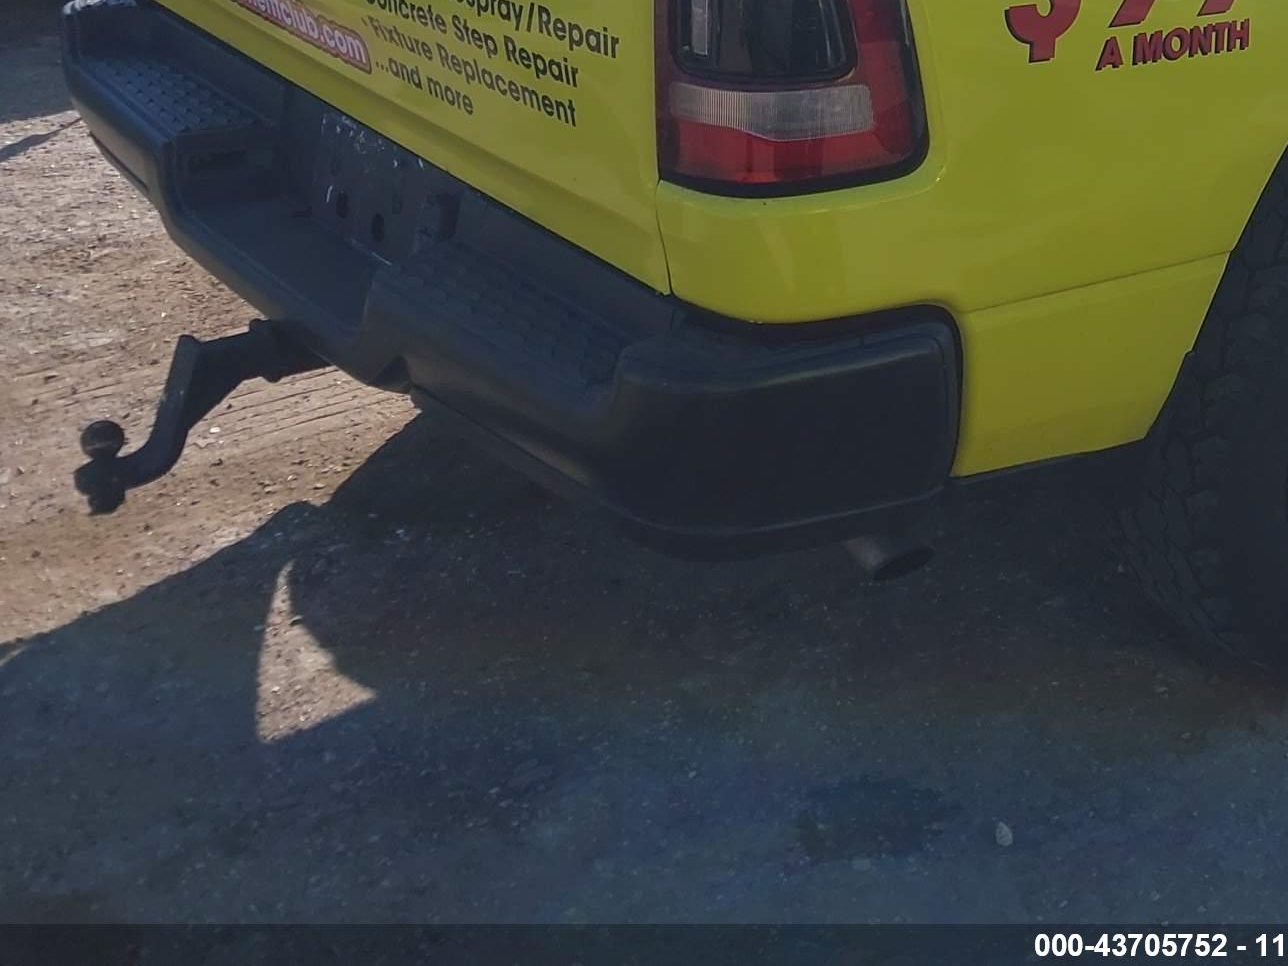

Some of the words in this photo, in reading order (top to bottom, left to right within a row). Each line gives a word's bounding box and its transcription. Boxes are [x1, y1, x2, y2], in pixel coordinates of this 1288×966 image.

[367, 15, 432, 61] Fixture
[436, 42, 576, 128] Replacement
[451, 15, 498, 58] Step
[503, 35, 579, 88] Repair
[1095, 37, 1124, 71] A
[1132, 18, 1250, 66] MONTH
[427, 75, 474, 115] more
